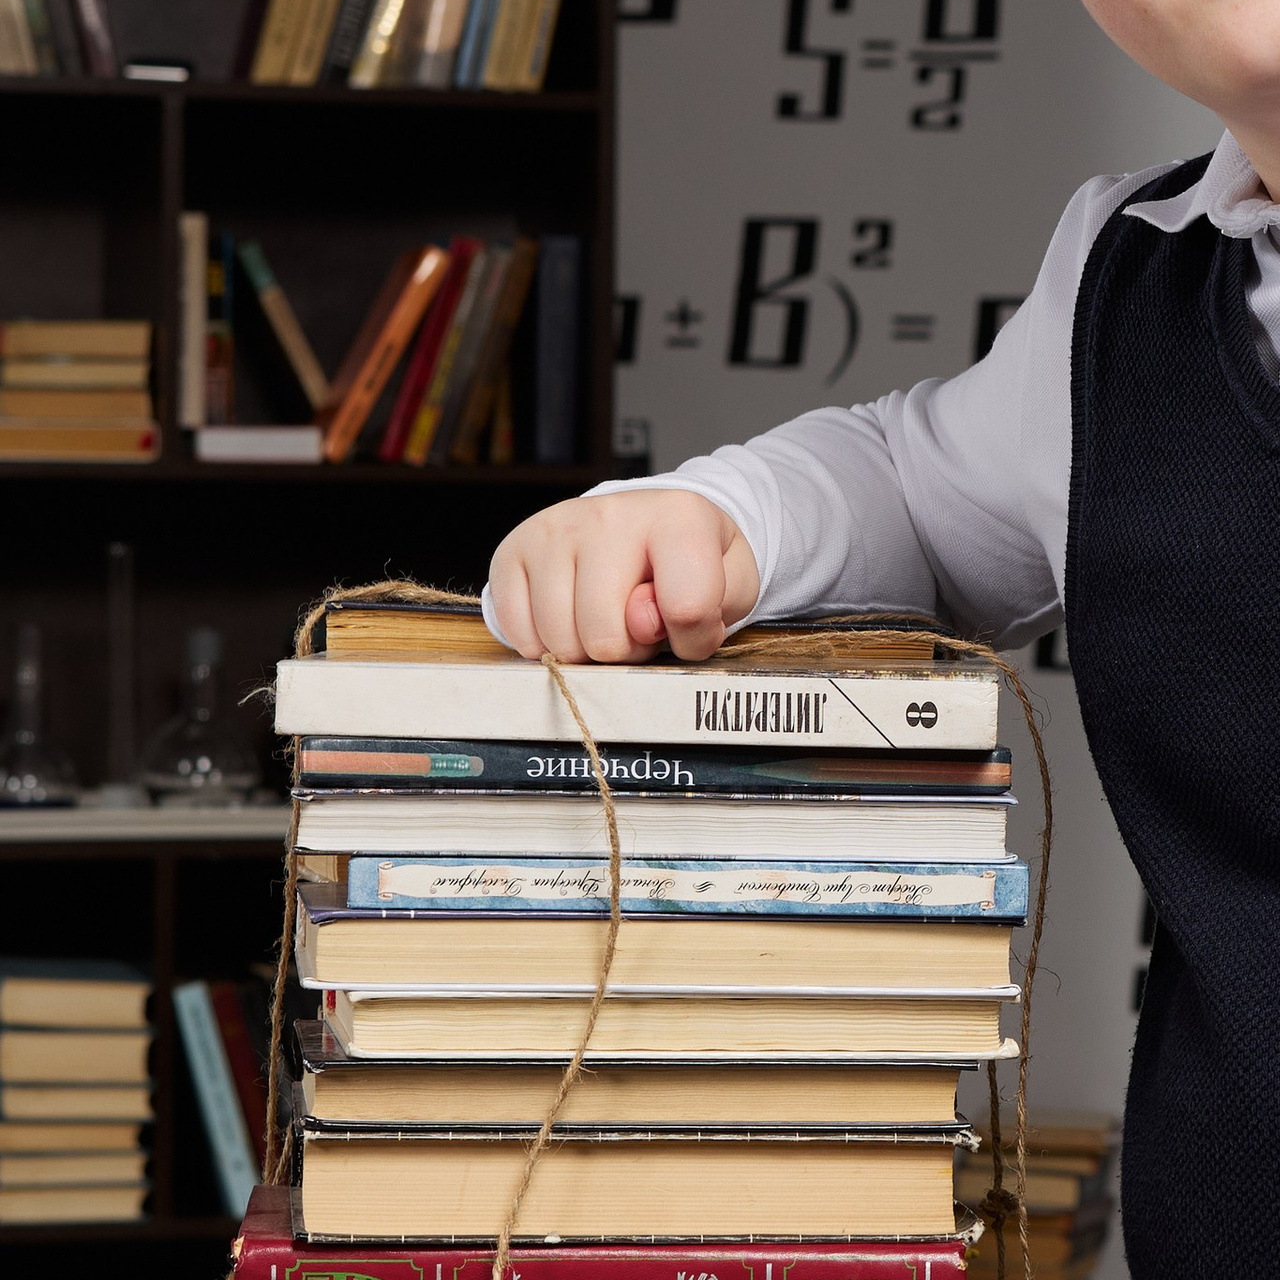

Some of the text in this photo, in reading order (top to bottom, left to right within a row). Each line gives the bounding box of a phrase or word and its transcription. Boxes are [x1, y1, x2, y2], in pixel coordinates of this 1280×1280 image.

[694, 687, 828, 734] ЛИТЕРАТУРА
[525, 749, 696, 787] Черчение
[429, 868, 676, 900] Ронал Фредерик Делдерфилд
[733, 874, 934, 906] Роберт Луис Стивенсон
